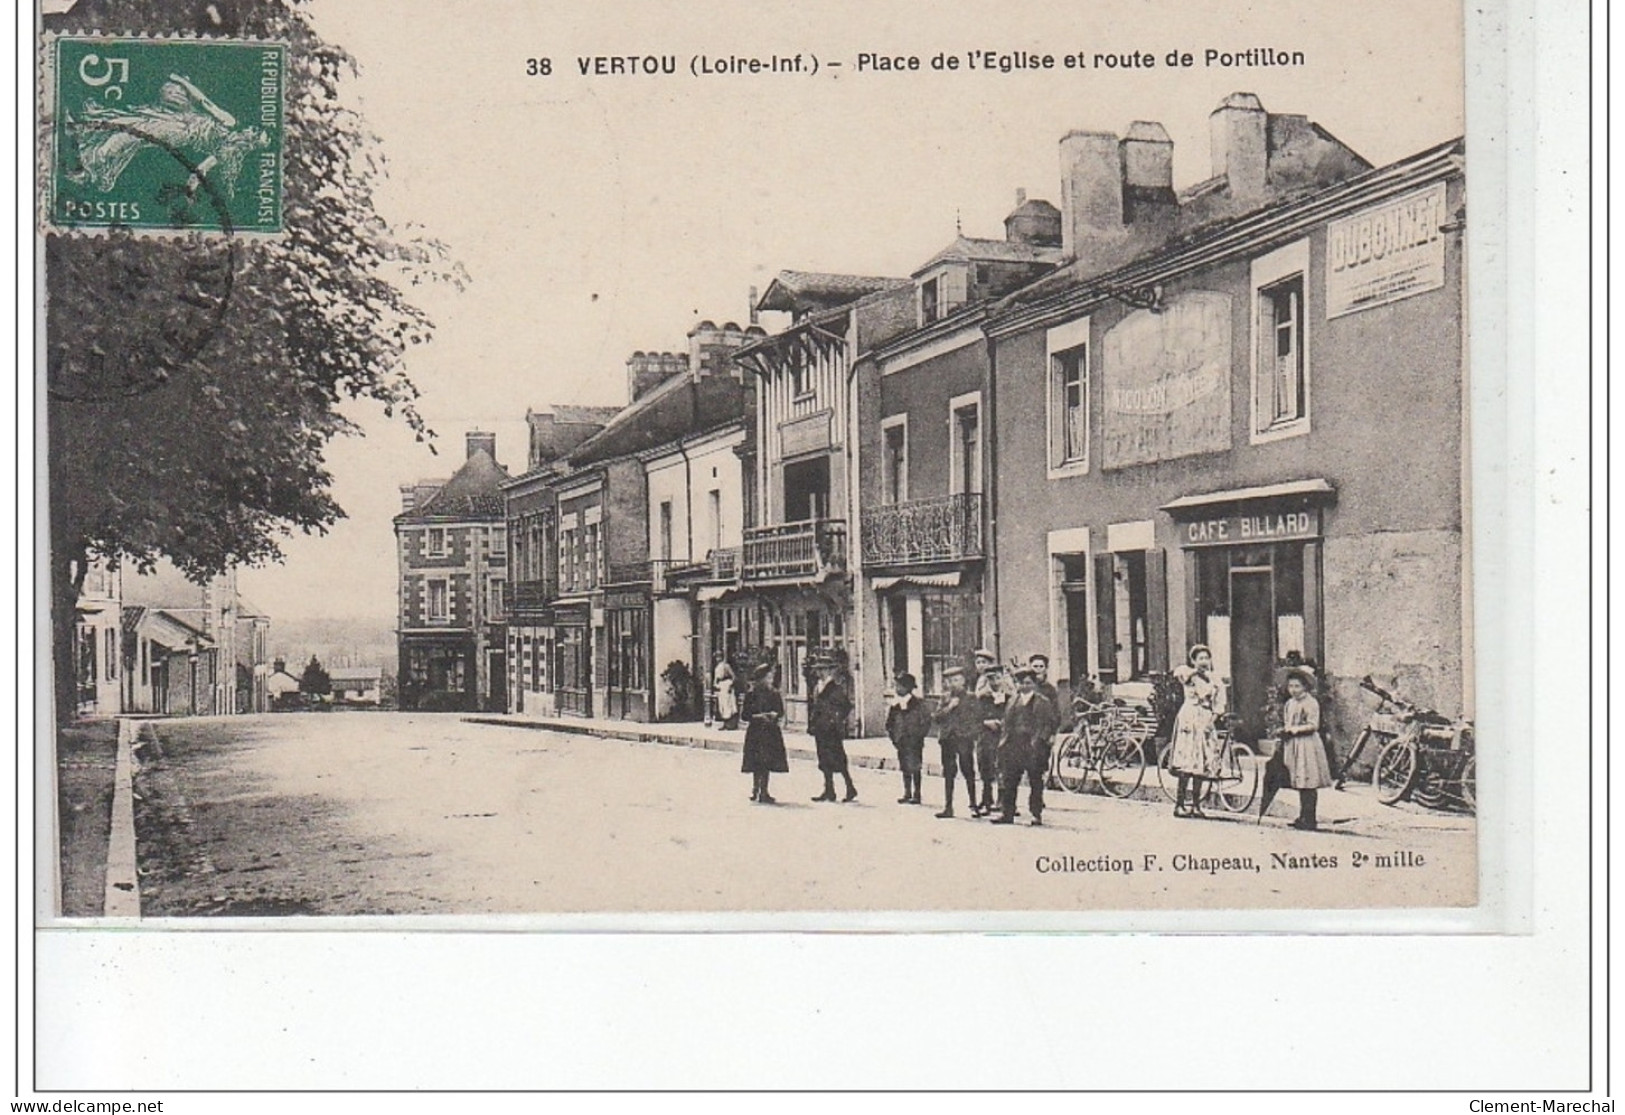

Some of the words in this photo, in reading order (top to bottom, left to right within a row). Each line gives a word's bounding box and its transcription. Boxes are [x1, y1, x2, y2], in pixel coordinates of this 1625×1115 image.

[65, 200, 140, 219] POSTES
[1331, 196, 1440, 273] DUBONNET
[1240, 512, 1311, 538] BILLARD
